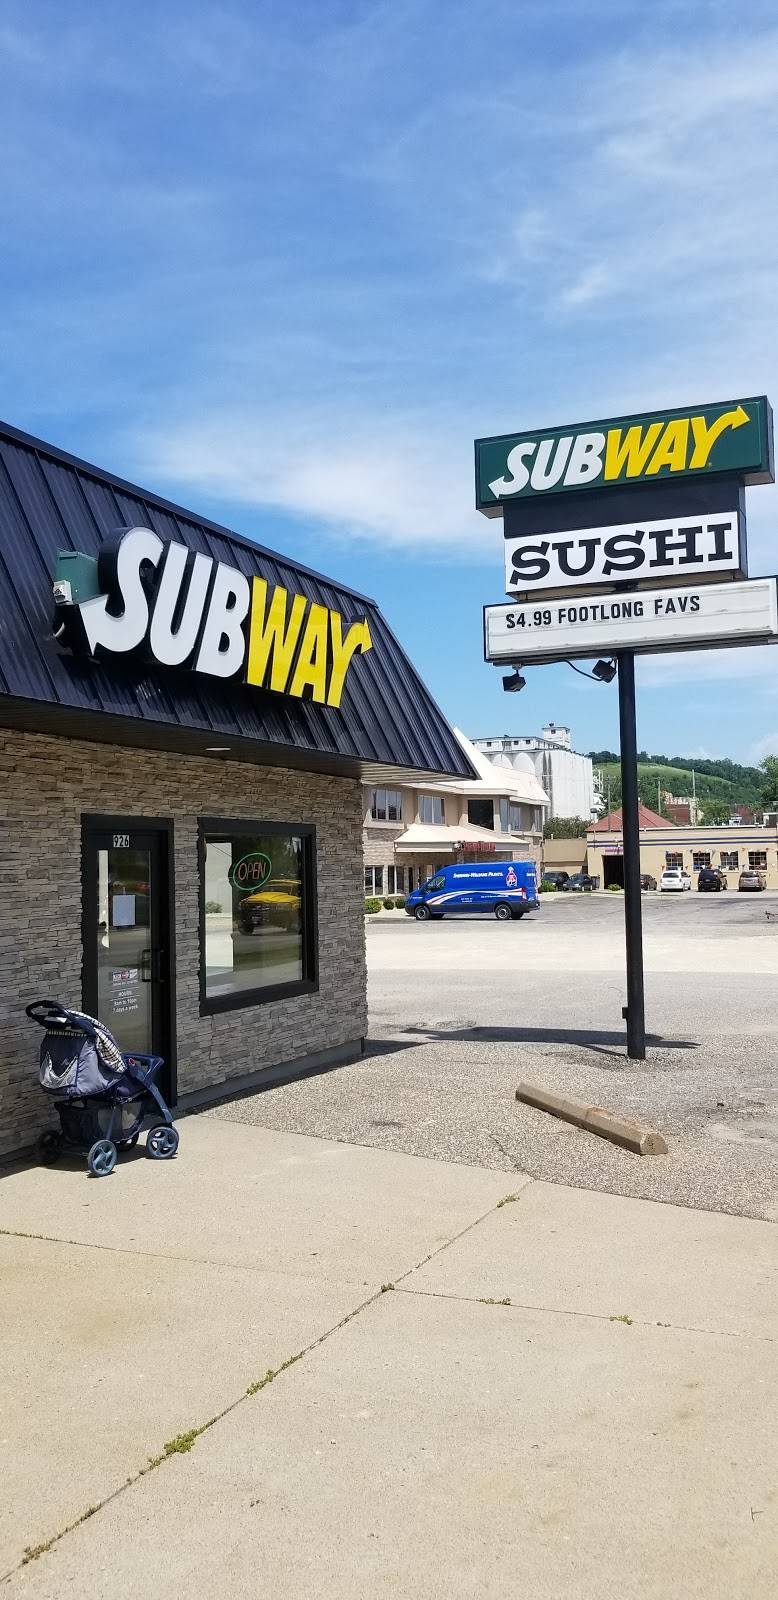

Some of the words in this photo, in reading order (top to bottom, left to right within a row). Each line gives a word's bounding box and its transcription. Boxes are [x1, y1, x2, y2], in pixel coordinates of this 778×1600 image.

[488, 405, 750, 499] SUBWAY
[509, 522, 733, 585] SUSHI
[79, 526, 373, 708] SUBWAY
[558, 601, 644, 624] FOOTLONG
[654, 595, 701, 615] FAVS
[113, 835, 129, 847] 926
[238, 862, 266, 881] OPEN
